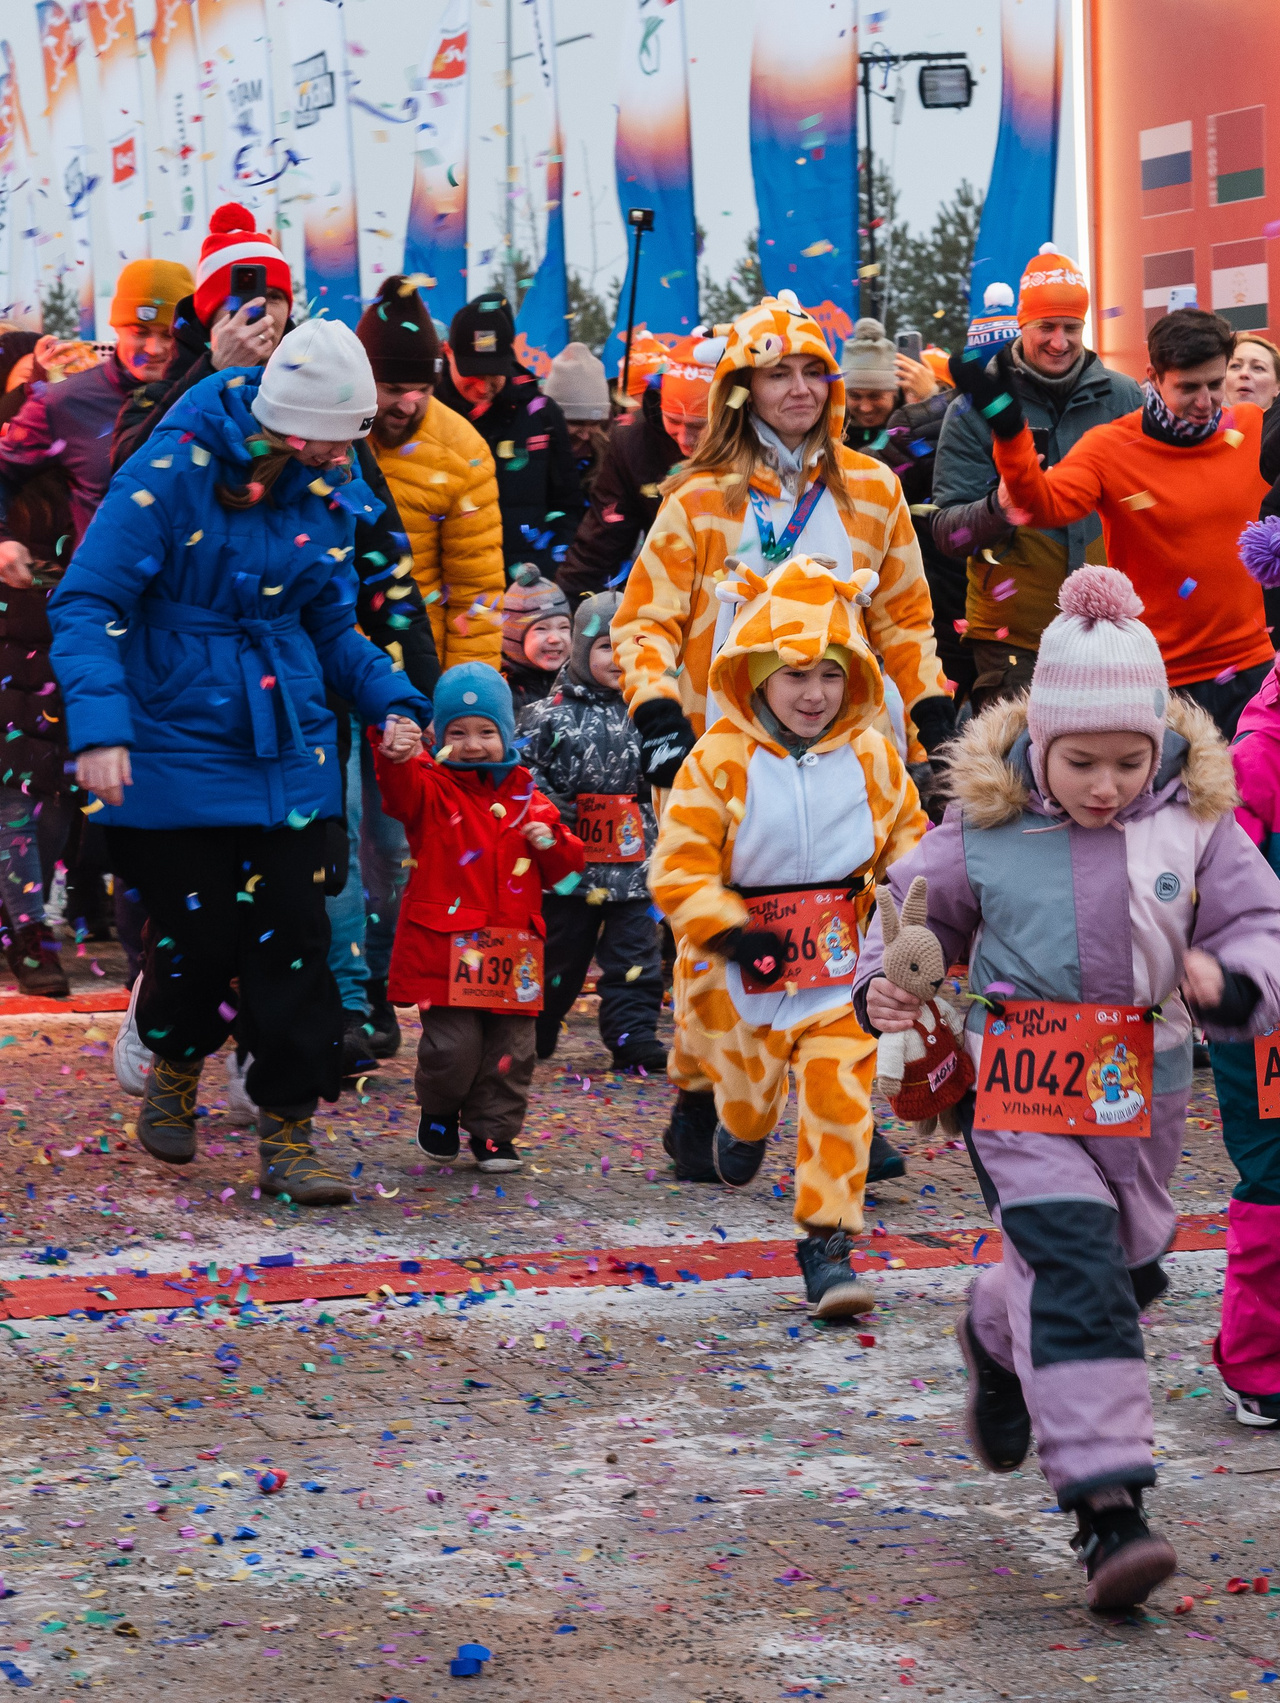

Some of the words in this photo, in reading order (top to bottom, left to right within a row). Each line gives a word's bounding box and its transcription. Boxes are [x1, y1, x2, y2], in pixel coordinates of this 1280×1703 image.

[579, 818, 613, 843] 061
[764, 903, 797, 924] RUN
[477, 938, 504, 949] RUN
[783, 926, 817, 963] 66
[455, 957, 513, 985] A139
[1005, 1006, 1045, 1025] FUN
[1022, 1017, 1067, 1038] RUN
[984, 1047, 1085, 1097] A042
[1002, 1101, 1063, 1117] УЛЬЯНА
